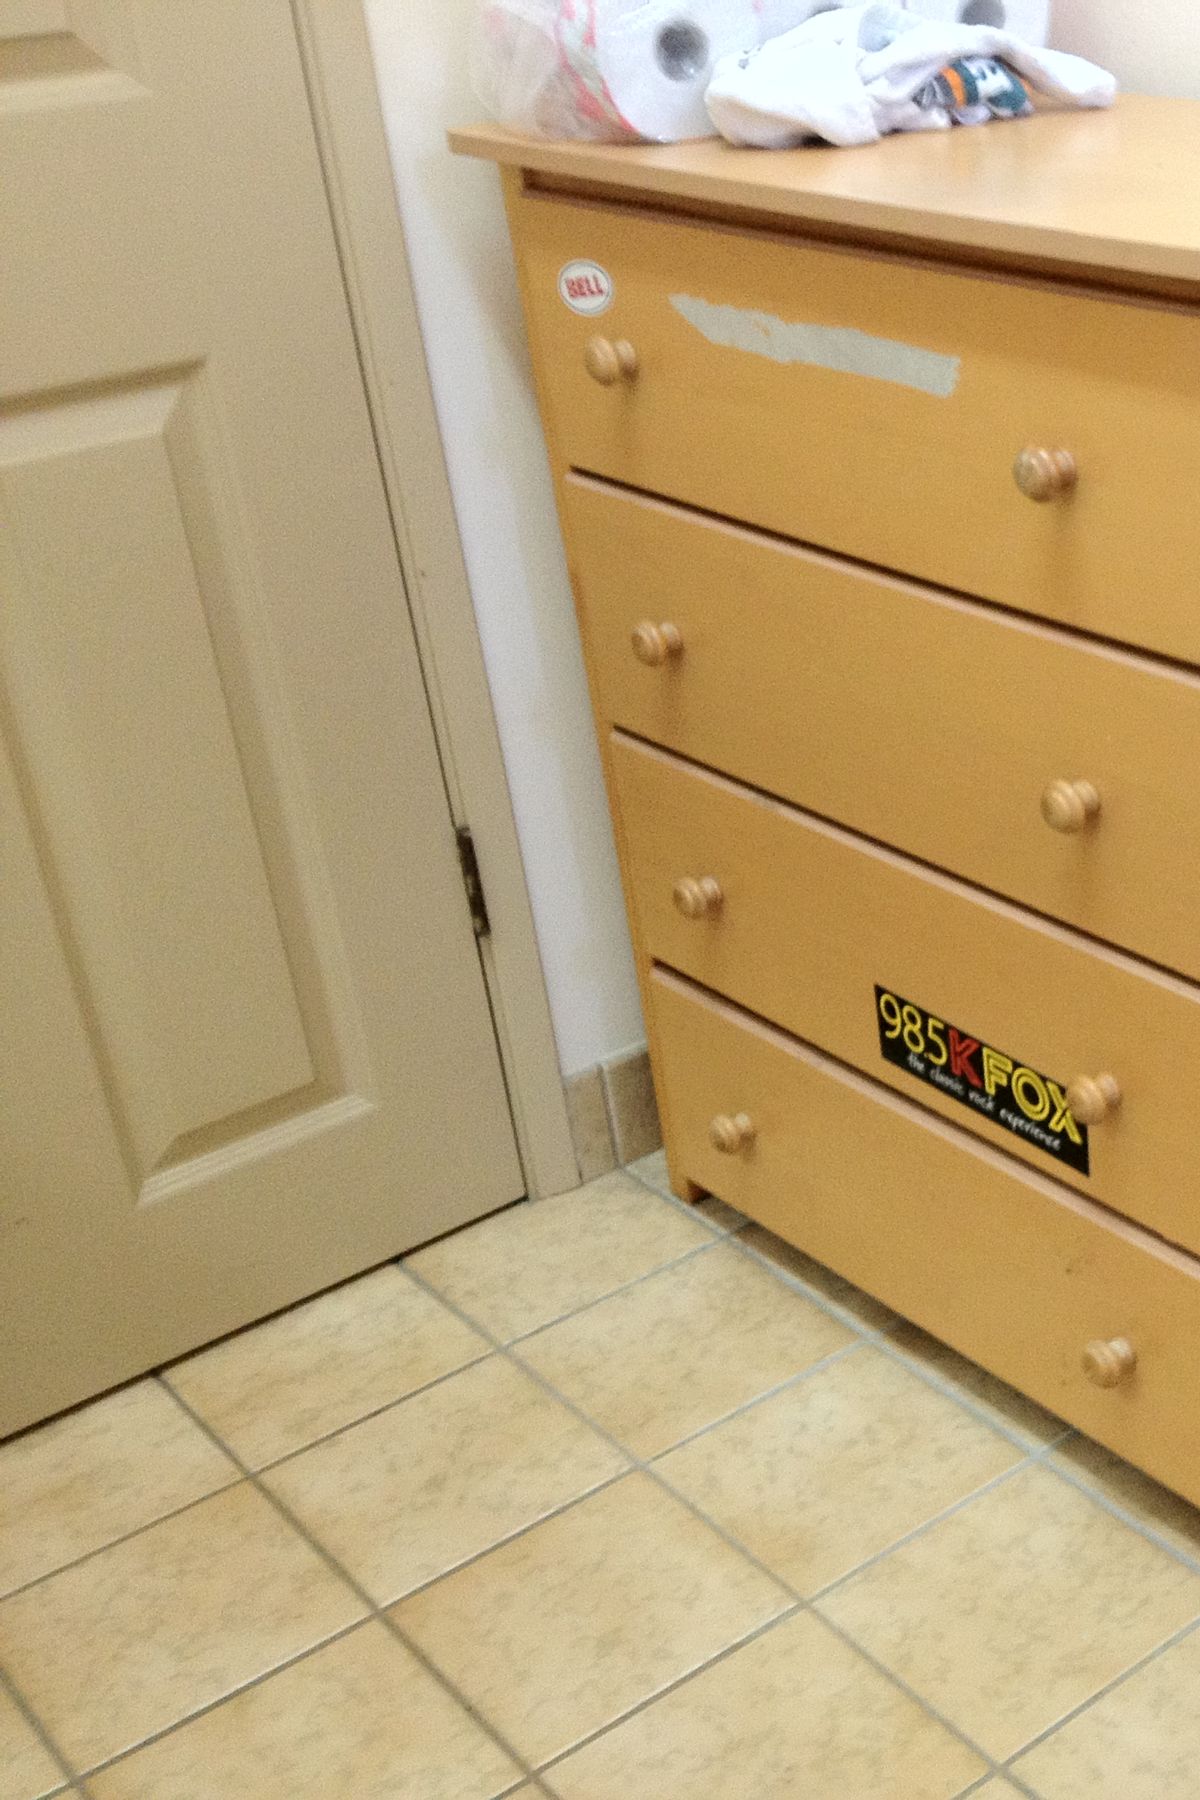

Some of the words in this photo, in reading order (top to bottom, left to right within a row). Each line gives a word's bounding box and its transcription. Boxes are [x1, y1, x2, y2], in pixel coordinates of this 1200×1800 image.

[564, 273, 605, 299] BELL
[907, 1051, 926, 1074] the
[928, 1065, 966, 1096] classic
[967, 1088, 996, 1112] rock
[999, 1106, 1061, 1151] experience
